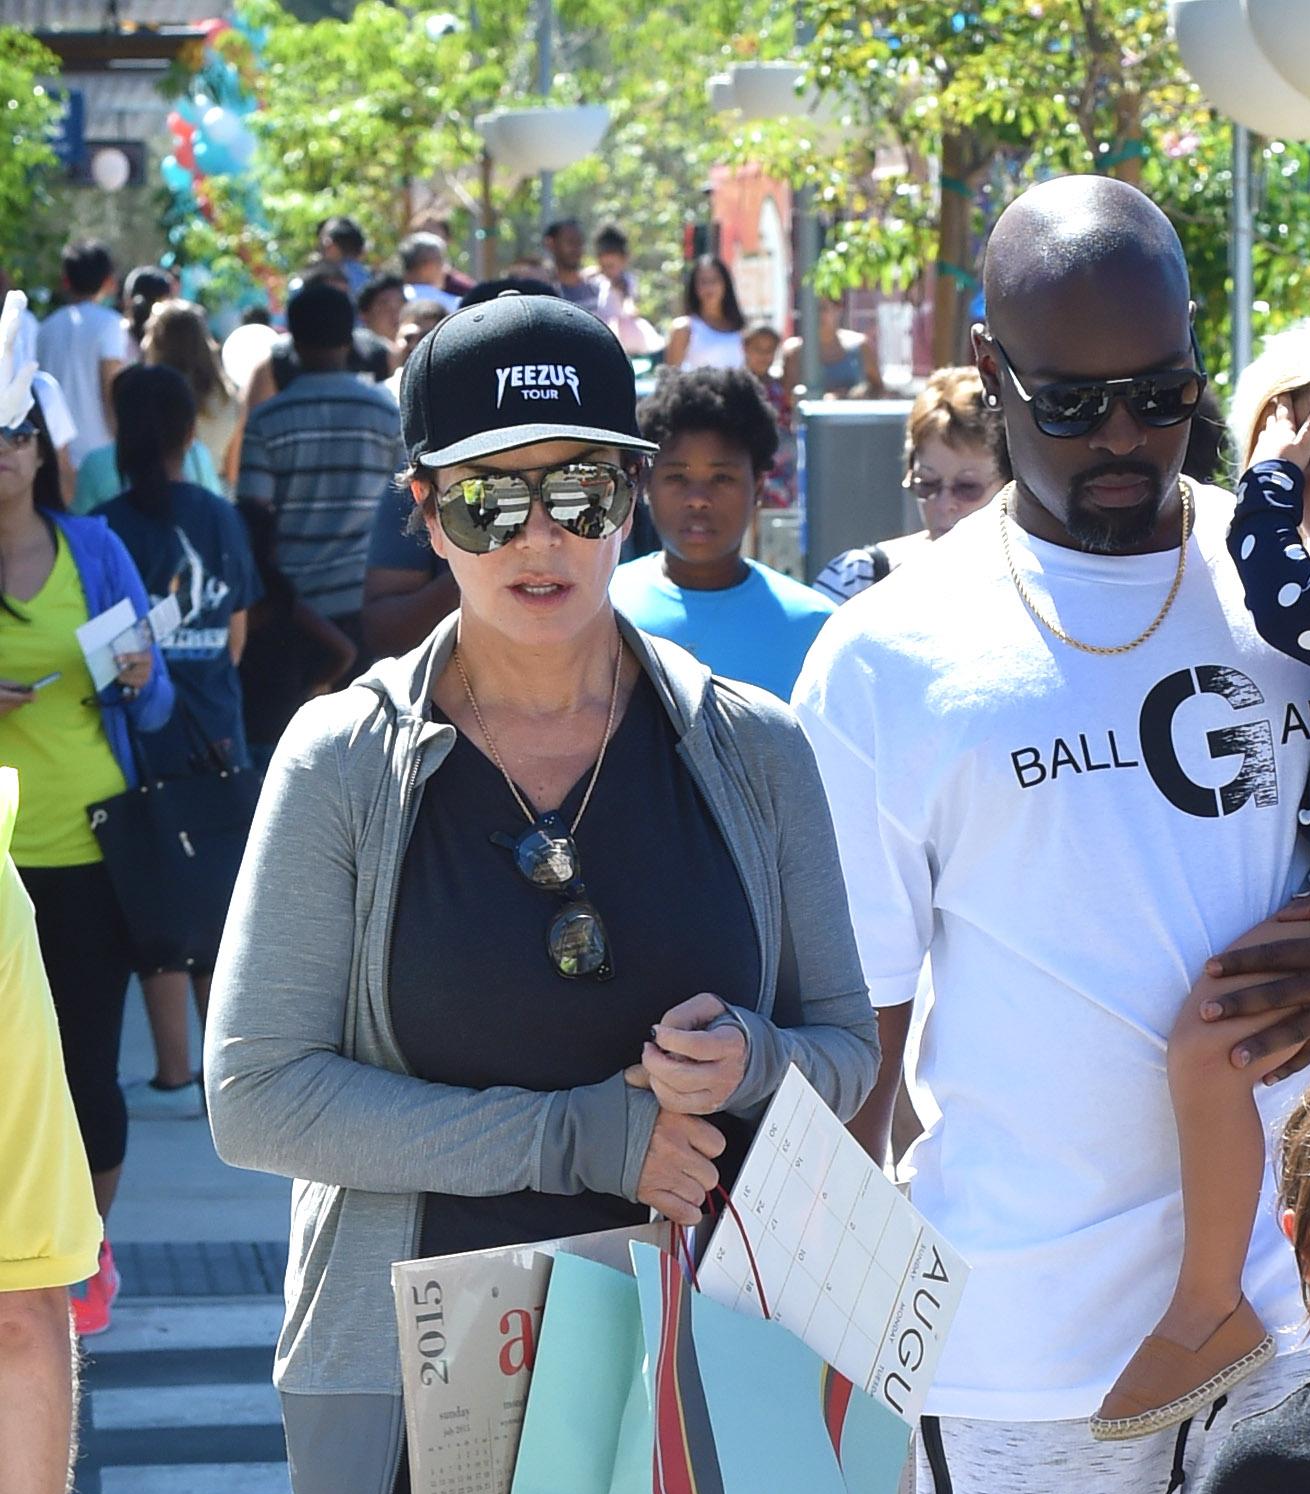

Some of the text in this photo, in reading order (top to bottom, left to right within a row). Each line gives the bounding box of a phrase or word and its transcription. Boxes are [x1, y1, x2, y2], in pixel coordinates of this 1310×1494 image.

[495, 364, 582, 409] YEEZUS
[520, 388, 559, 400] TOUR
[1010, 730, 1139, 789] BALL
[411, 1280, 449, 1387] 2015
[890, 1303, 907, 1344] MONDAY
